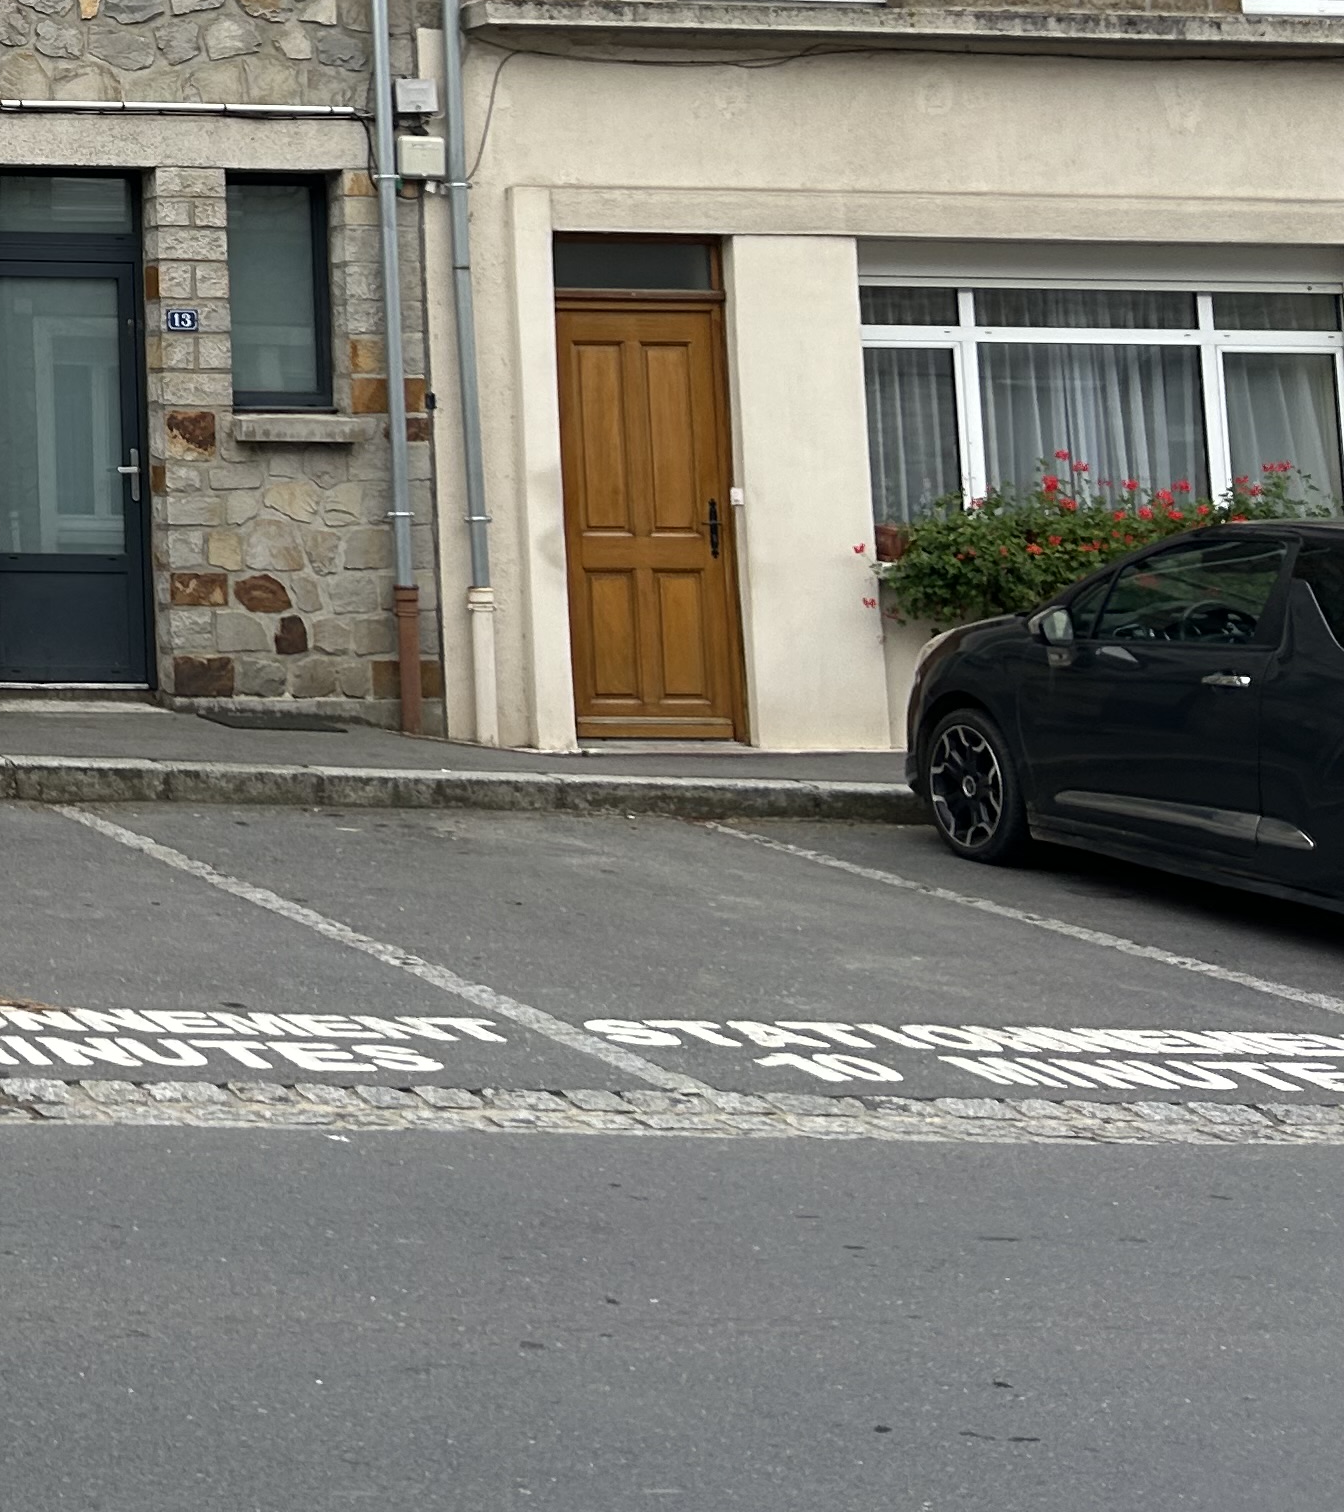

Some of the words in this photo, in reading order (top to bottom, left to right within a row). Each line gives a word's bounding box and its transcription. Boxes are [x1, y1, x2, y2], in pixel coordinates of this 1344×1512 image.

[173, 312, 193, 327] 13
[753, 1051, 905, 1083] 10
[937, 1054, 1344, 1093] MINUTE
